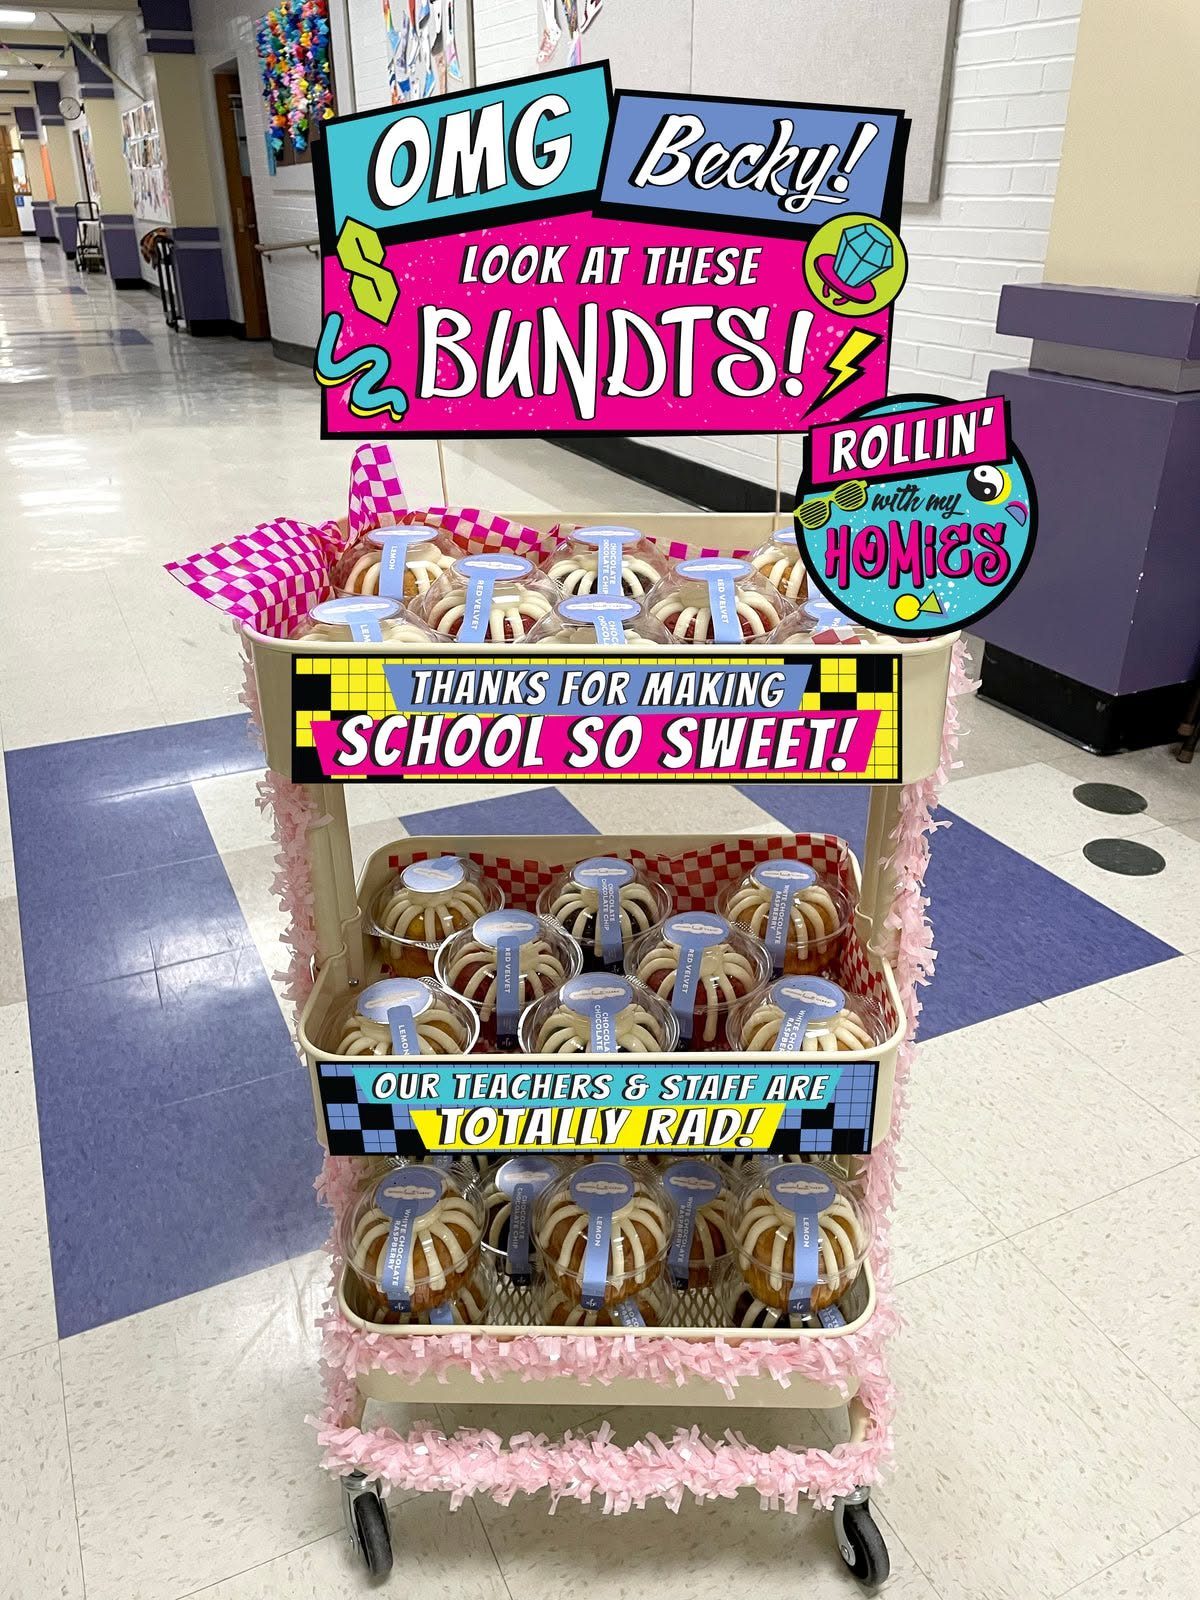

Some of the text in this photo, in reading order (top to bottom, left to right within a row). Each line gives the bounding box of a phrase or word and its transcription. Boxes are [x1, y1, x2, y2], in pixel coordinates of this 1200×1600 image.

[369, 94, 573, 209] OMG
[628, 114, 879, 212] Becky!
[459, 245, 762, 286] LOOK AT THESE
[416, 303, 814, 420] BUNDTS!
[830, 406, 995, 474] ROLLIN'
[871, 484, 965, 519] with my
[389, 545, 398, 571] LEMON
[471, 580, 485, 631] RED VELVET
[719, 594, 729, 624] VELVET
[411, 669, 786, 708] THANKS FOR MAKING
[334, 714, 859, 772] SCHOOL SO SWEET!
[770, 890, 782, 930] RASPBERRY
[774, 902, 786, 945] CHOCOLATE
[504, 947, 512, 962] RED
[681, 948, 695, 994] RED VELVET
[594, 1004, 604, 1051] CHOCOLATE
[792, 1009, 806, 1031] WHITE
[372, 1071, 830, 1102] OUR TEACHERS & STAFF ARE
[435, 1107, 766, 1147] TOTALLY RAD!
[513, 1187, 523, 1229] CHOCOLATE
[518, 1195, 528, 1240] CHOCOLATE
[676, 1204, 686, 1248] RASPBERRY
[388, 1220, 401, 1270] RASPBERRY
[392, 1208, 411, 1287] WHITE CHOCOLATE
[594, 1216, 603, 1247] LEMON
[677, 1218, 690, 1263] CHOCOLATE
[802, 1217, 810, 1249] LEMON
